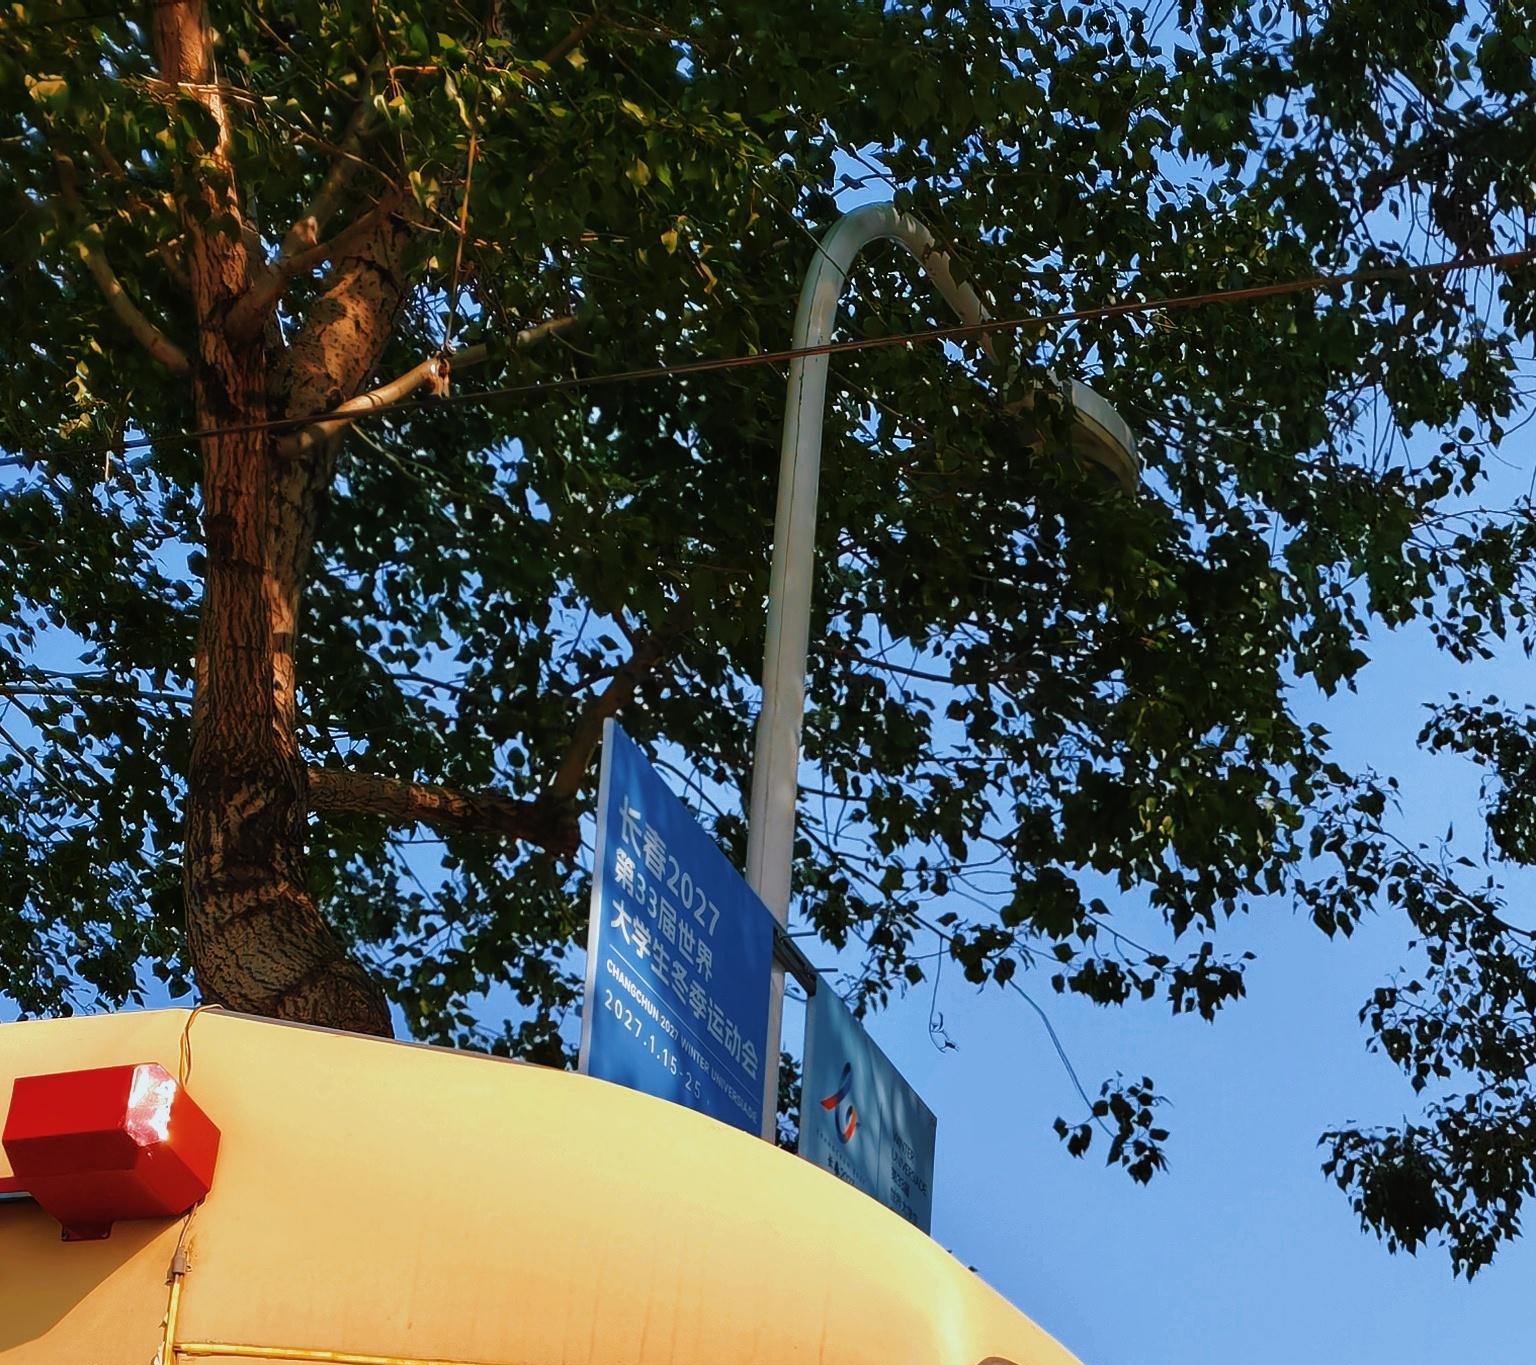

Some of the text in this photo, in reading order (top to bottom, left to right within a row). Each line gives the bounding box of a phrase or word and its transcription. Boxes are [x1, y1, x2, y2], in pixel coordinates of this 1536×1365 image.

[606, 957, 660, 1023] CHANGCHUN
[610, 899, 758, 1081] 大学生冬季运动会
